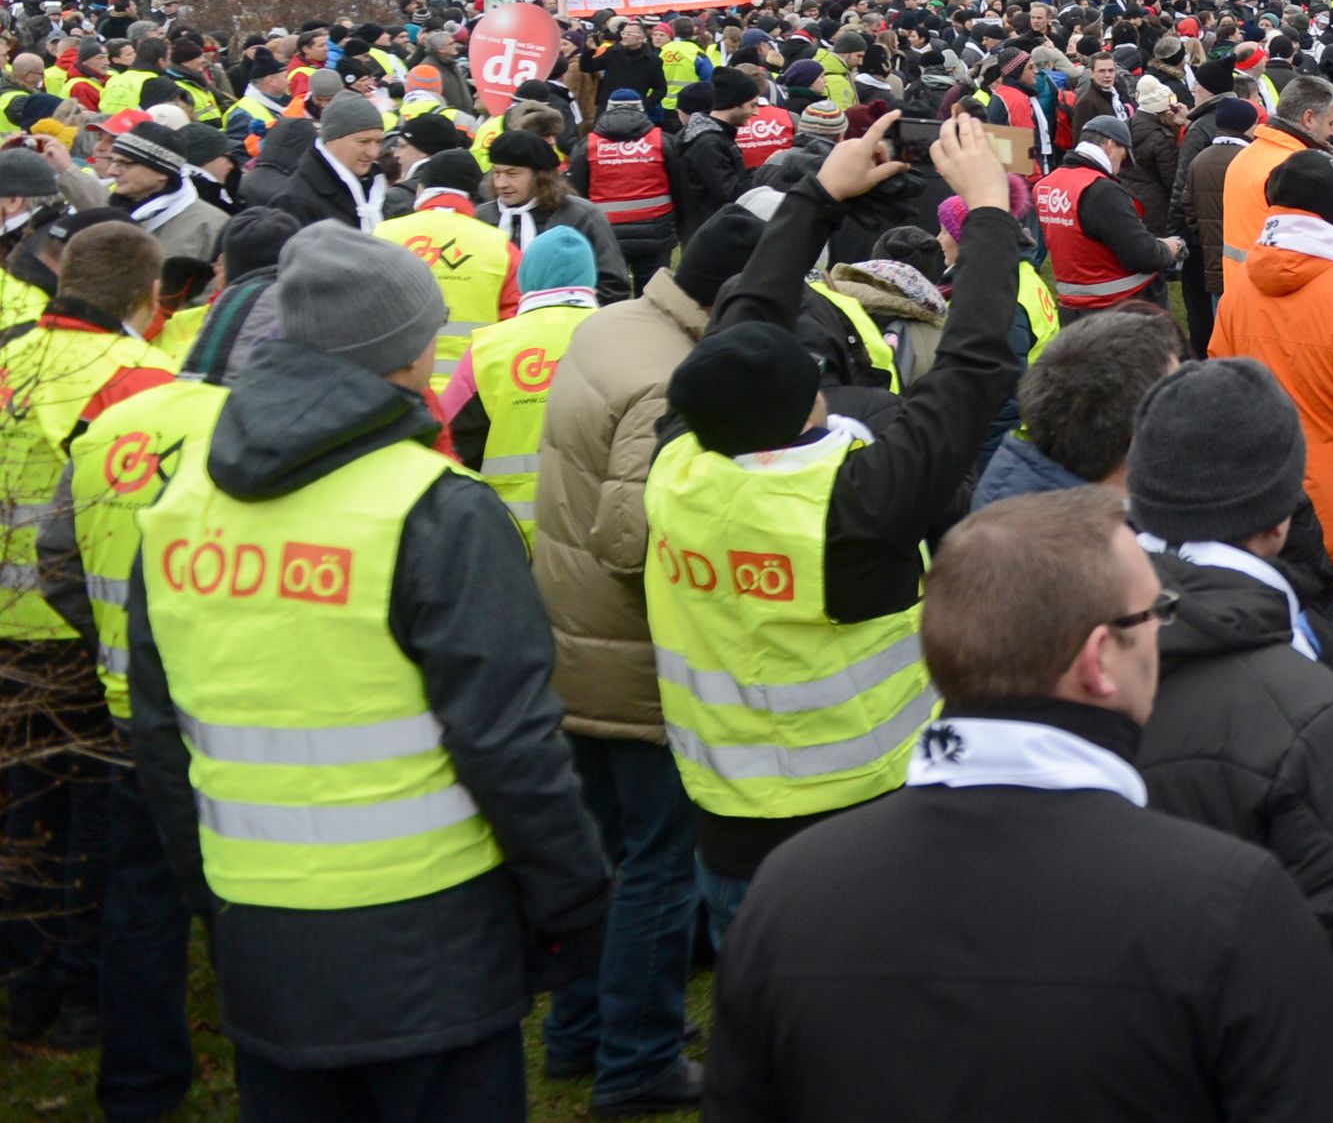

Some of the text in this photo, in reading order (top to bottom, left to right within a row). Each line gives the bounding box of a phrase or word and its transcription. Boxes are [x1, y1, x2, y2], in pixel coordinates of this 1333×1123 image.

[482, 38, 538, 87] da
[163, 528, 266, 598] GÖD
[658, 534, 717, 593] ÖD
